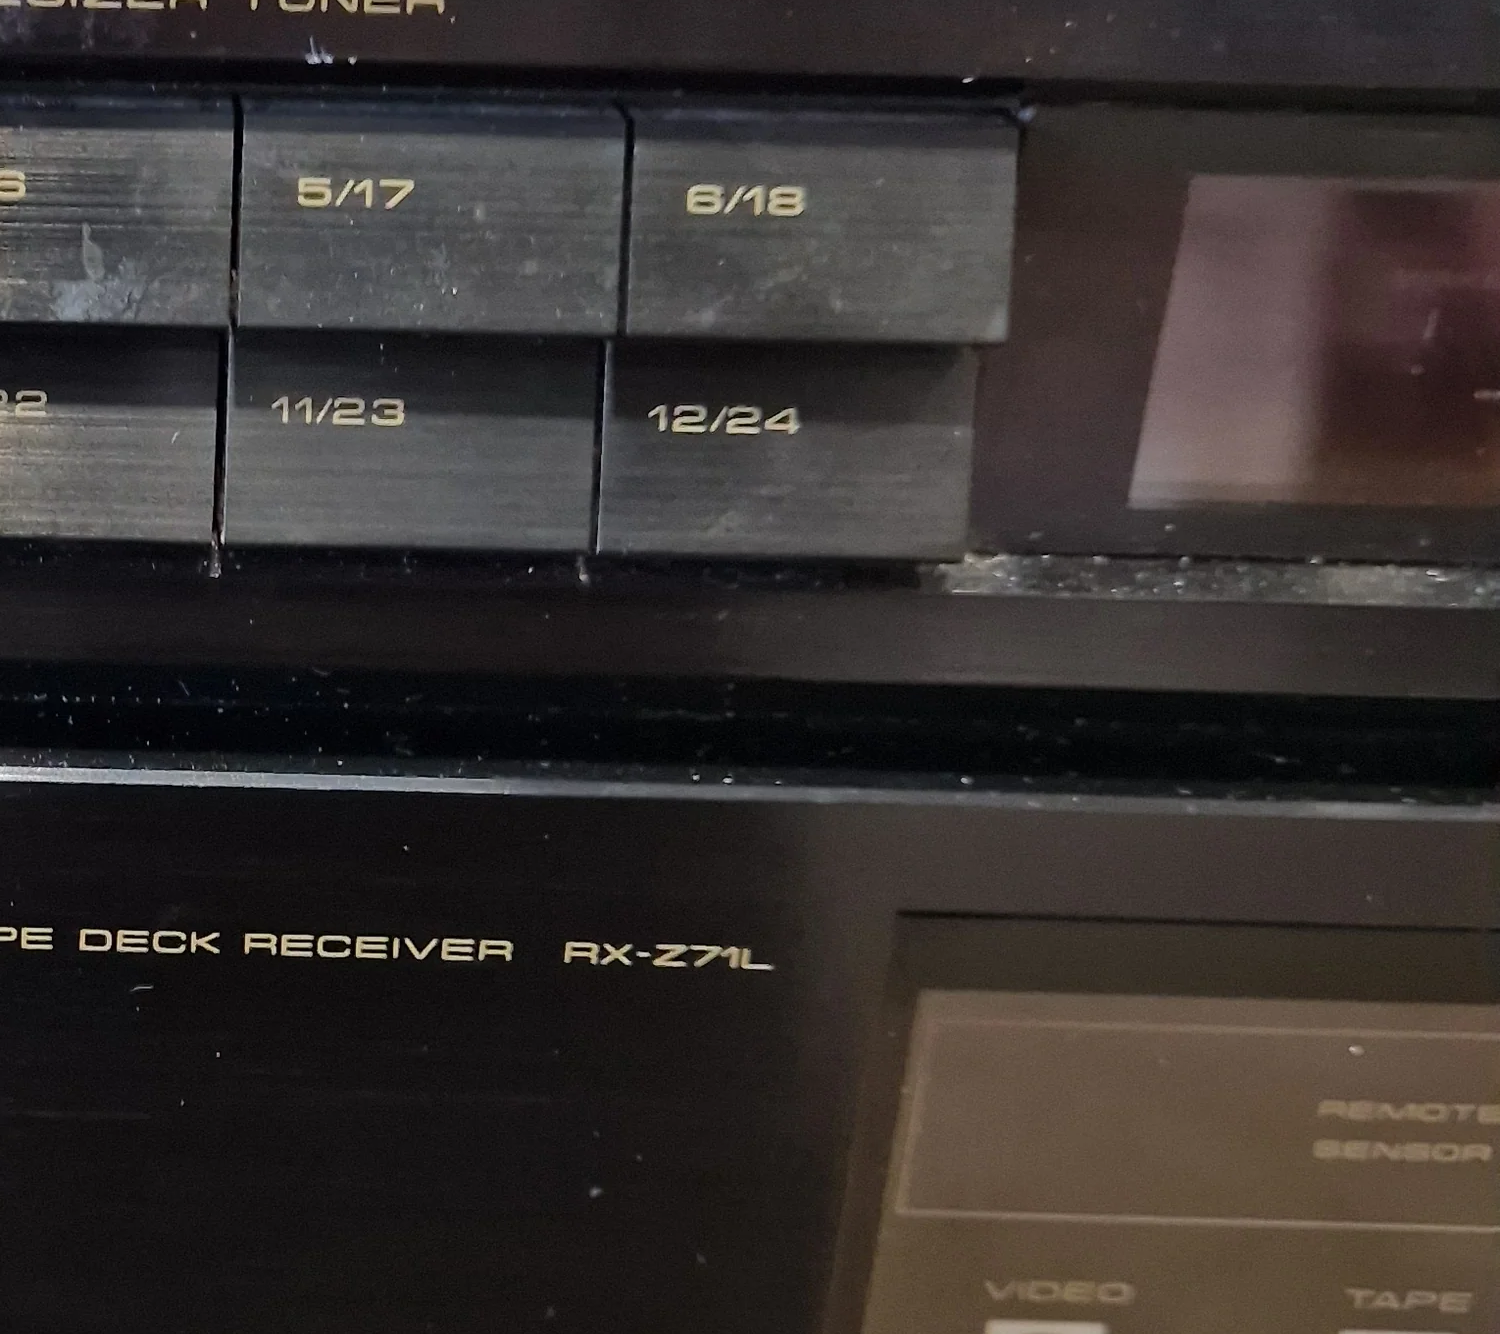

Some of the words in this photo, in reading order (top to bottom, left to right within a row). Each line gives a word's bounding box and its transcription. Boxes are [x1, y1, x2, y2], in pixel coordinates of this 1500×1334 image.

[297, 176, 415, 210] 5/17
[685, 183, 806, 218] 6/18
[271, 396, 406, 427] 11/23
[647, 404, 801, 435] 12/24
[78, 928, 221, 954] DECK
[243, 932, 514, 962] RECEIVER
[563, 941, 775, 971] RX-Z71L
[1316, 1099, 1500, 1125] REMOTE
[1313, 1139, 1493, 1163] SENSOR
[984, 1280, 1136, 1305] VIDEO
[1344, 1287, 1473, 1314] TAPE
